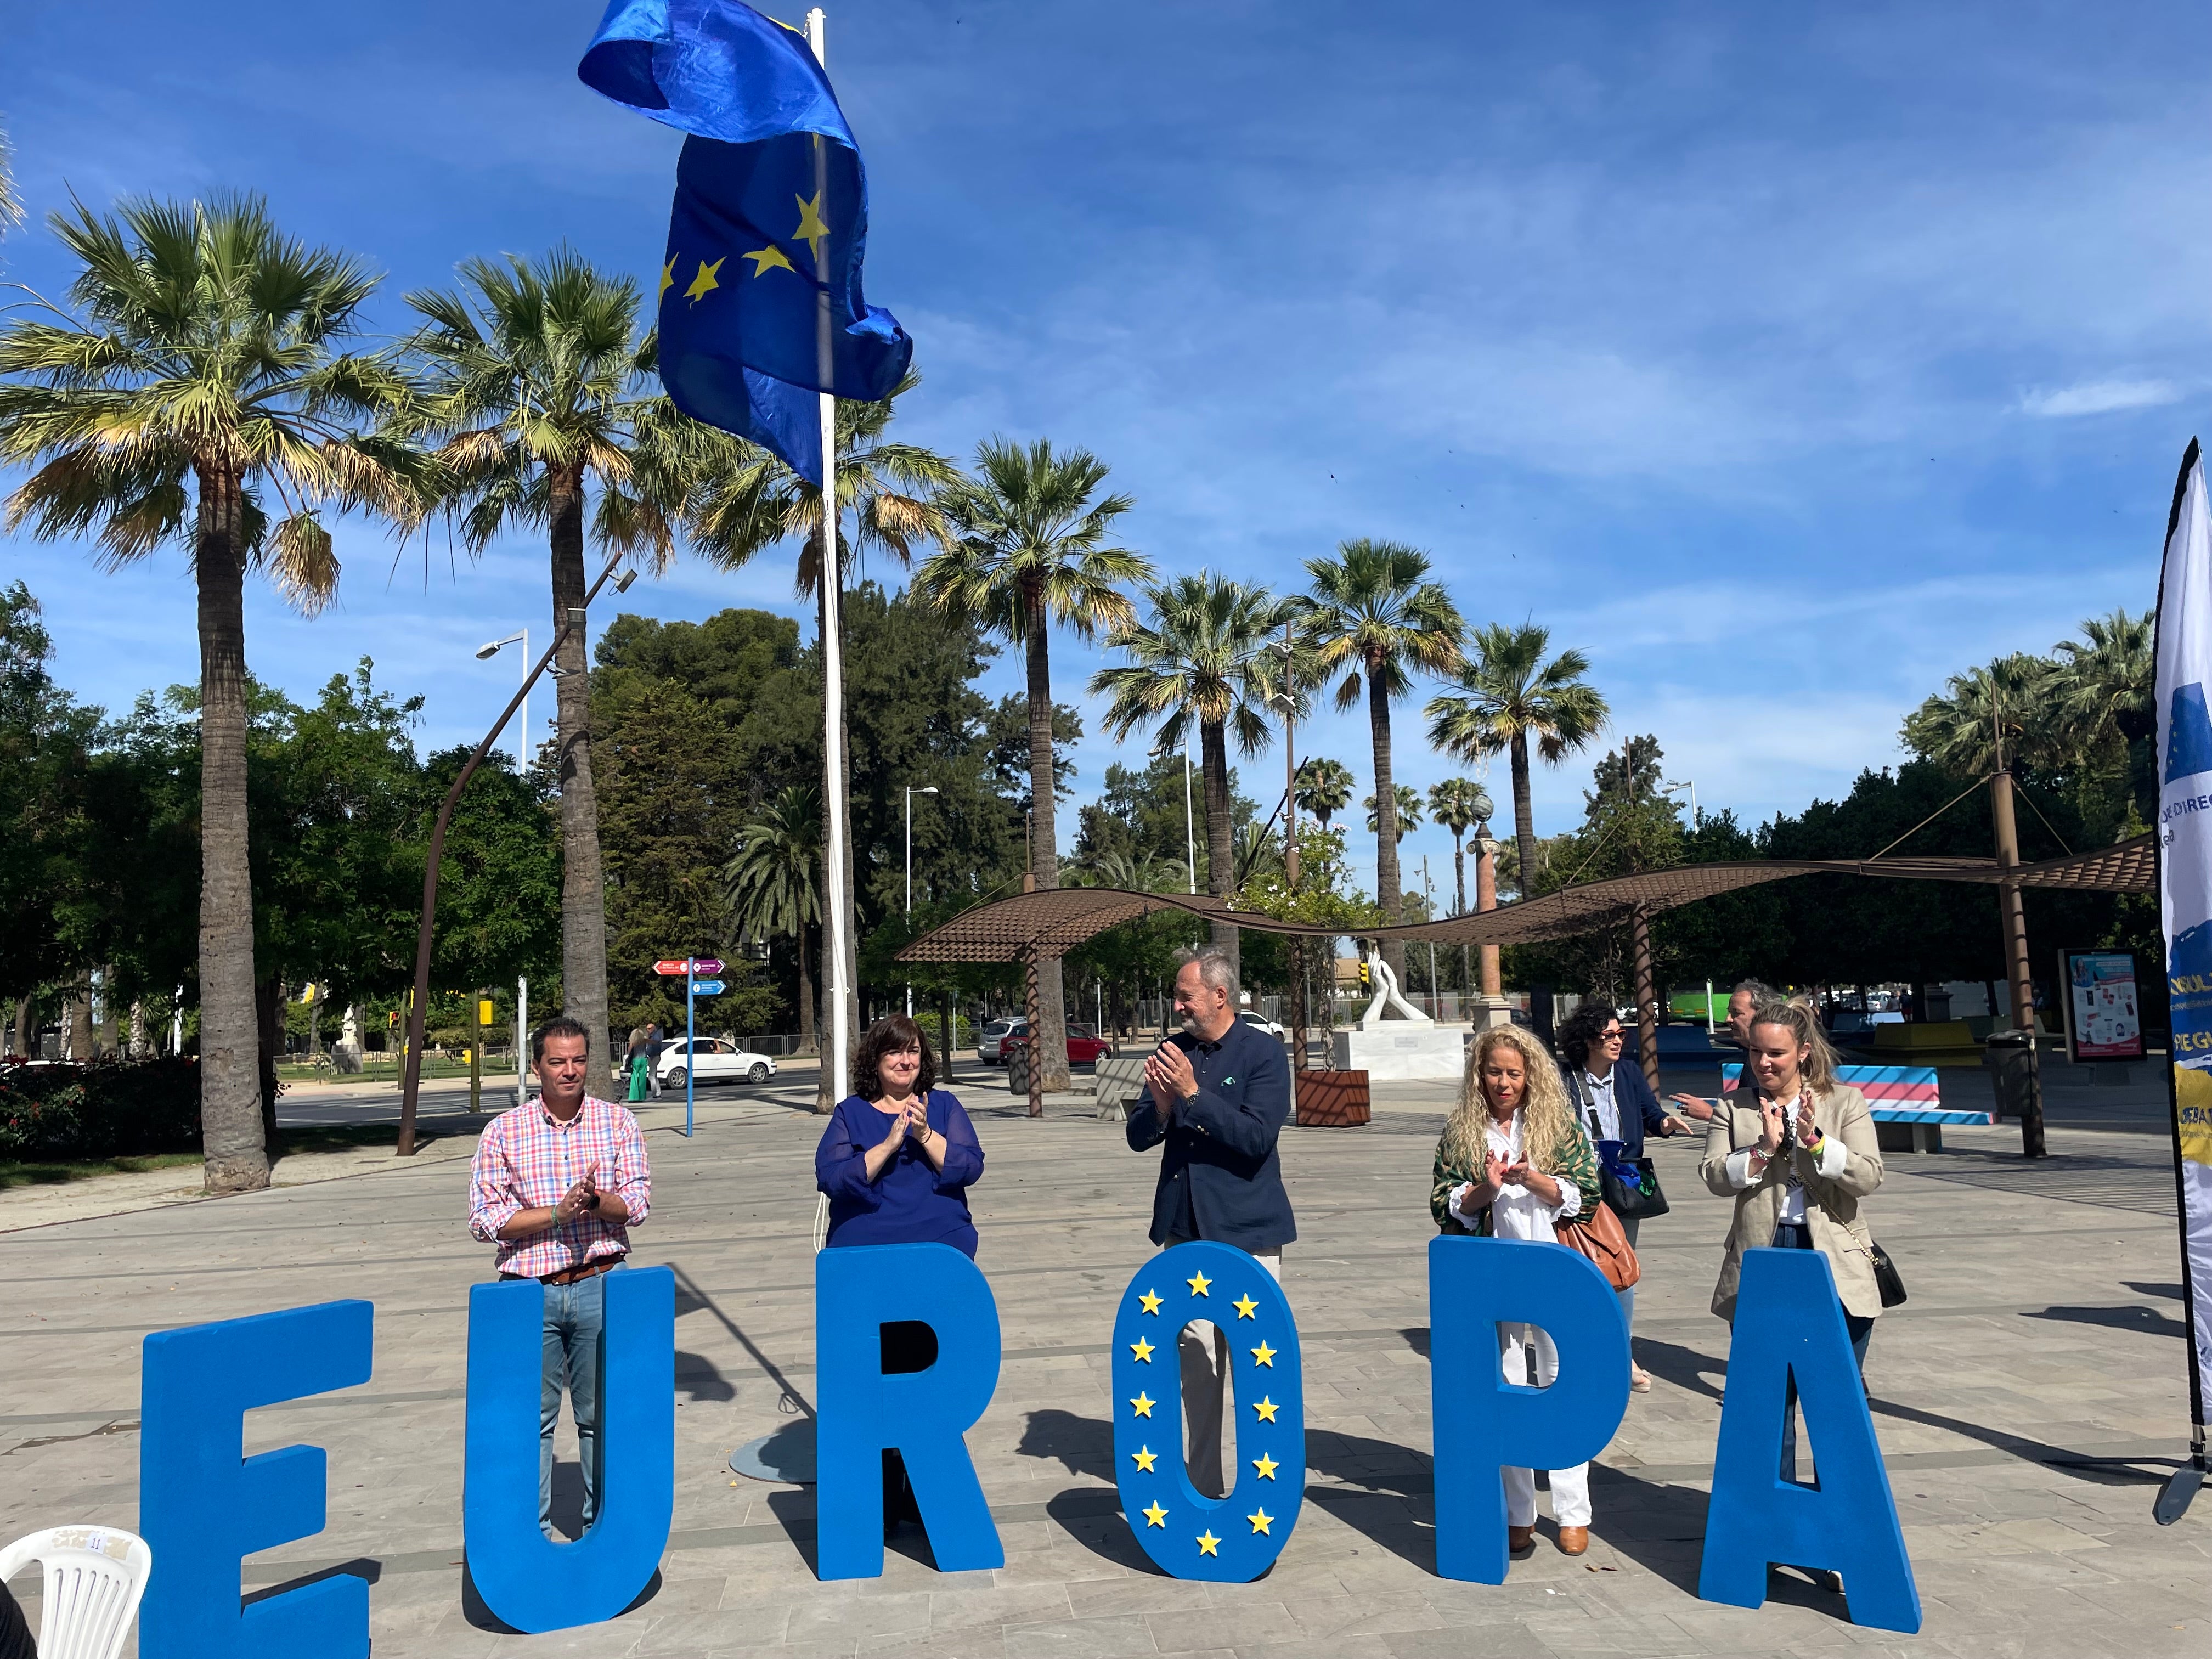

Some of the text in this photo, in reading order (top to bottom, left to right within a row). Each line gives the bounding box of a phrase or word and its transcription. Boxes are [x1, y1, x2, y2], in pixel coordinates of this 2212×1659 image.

[2174, 794, 2212, 816] DIRE
[139, 1234, 1922, 1659] EUROPA
[91, 1538, 100, 1550] 11
